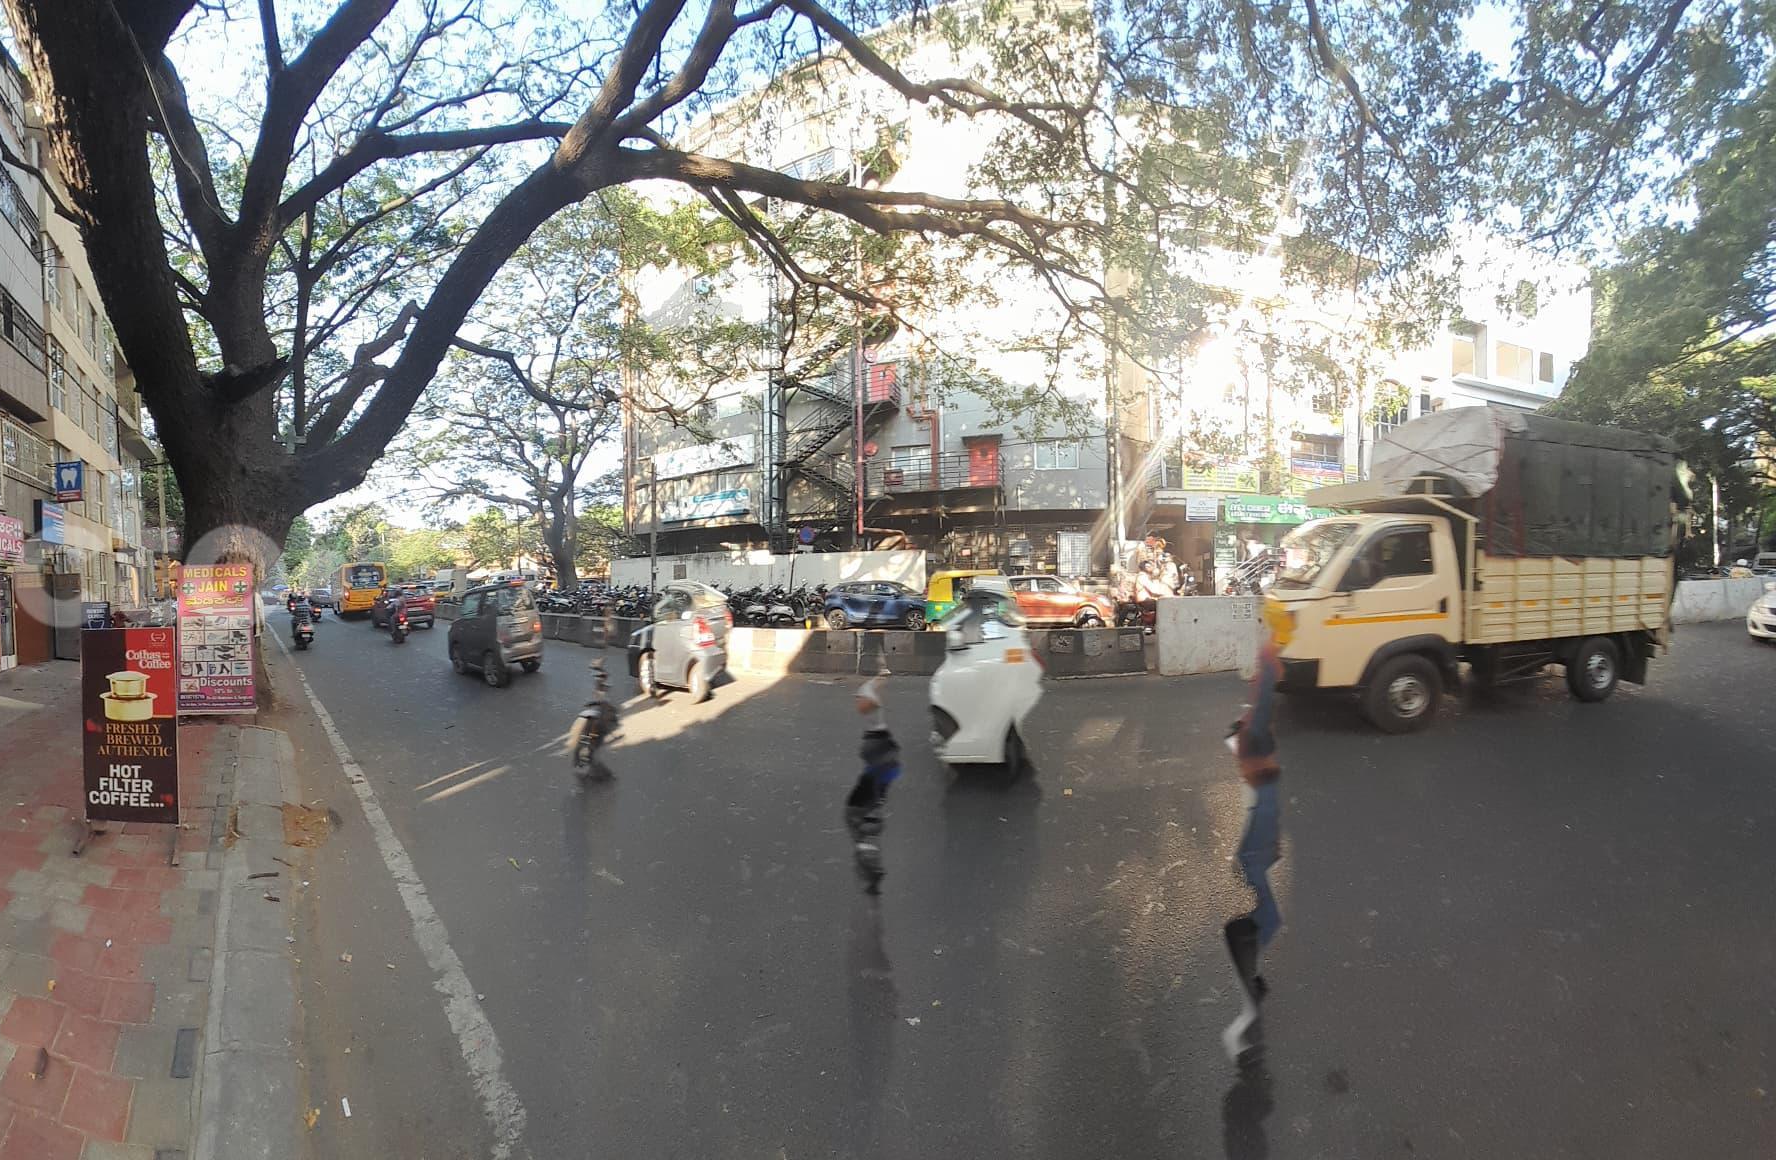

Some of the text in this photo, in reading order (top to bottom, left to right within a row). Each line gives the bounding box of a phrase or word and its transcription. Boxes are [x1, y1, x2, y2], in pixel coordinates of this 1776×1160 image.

[183, 567, 247, 578] MEDICALS
[198, 580, 228, 593] JAIN
[125, 649, 161, 660] Cothas
[138, 659, 171, 669] Coffee
[200, 677, 253, 687] Discounts
[106, 723, 161, 734] FRESHLY
[106, 734, 162, 746] BREWED
[97, 745, 173, 757] AUTHENTIC
[109, 764, 142, 778] HOT
[99, 778, 153, 793] FILTER
